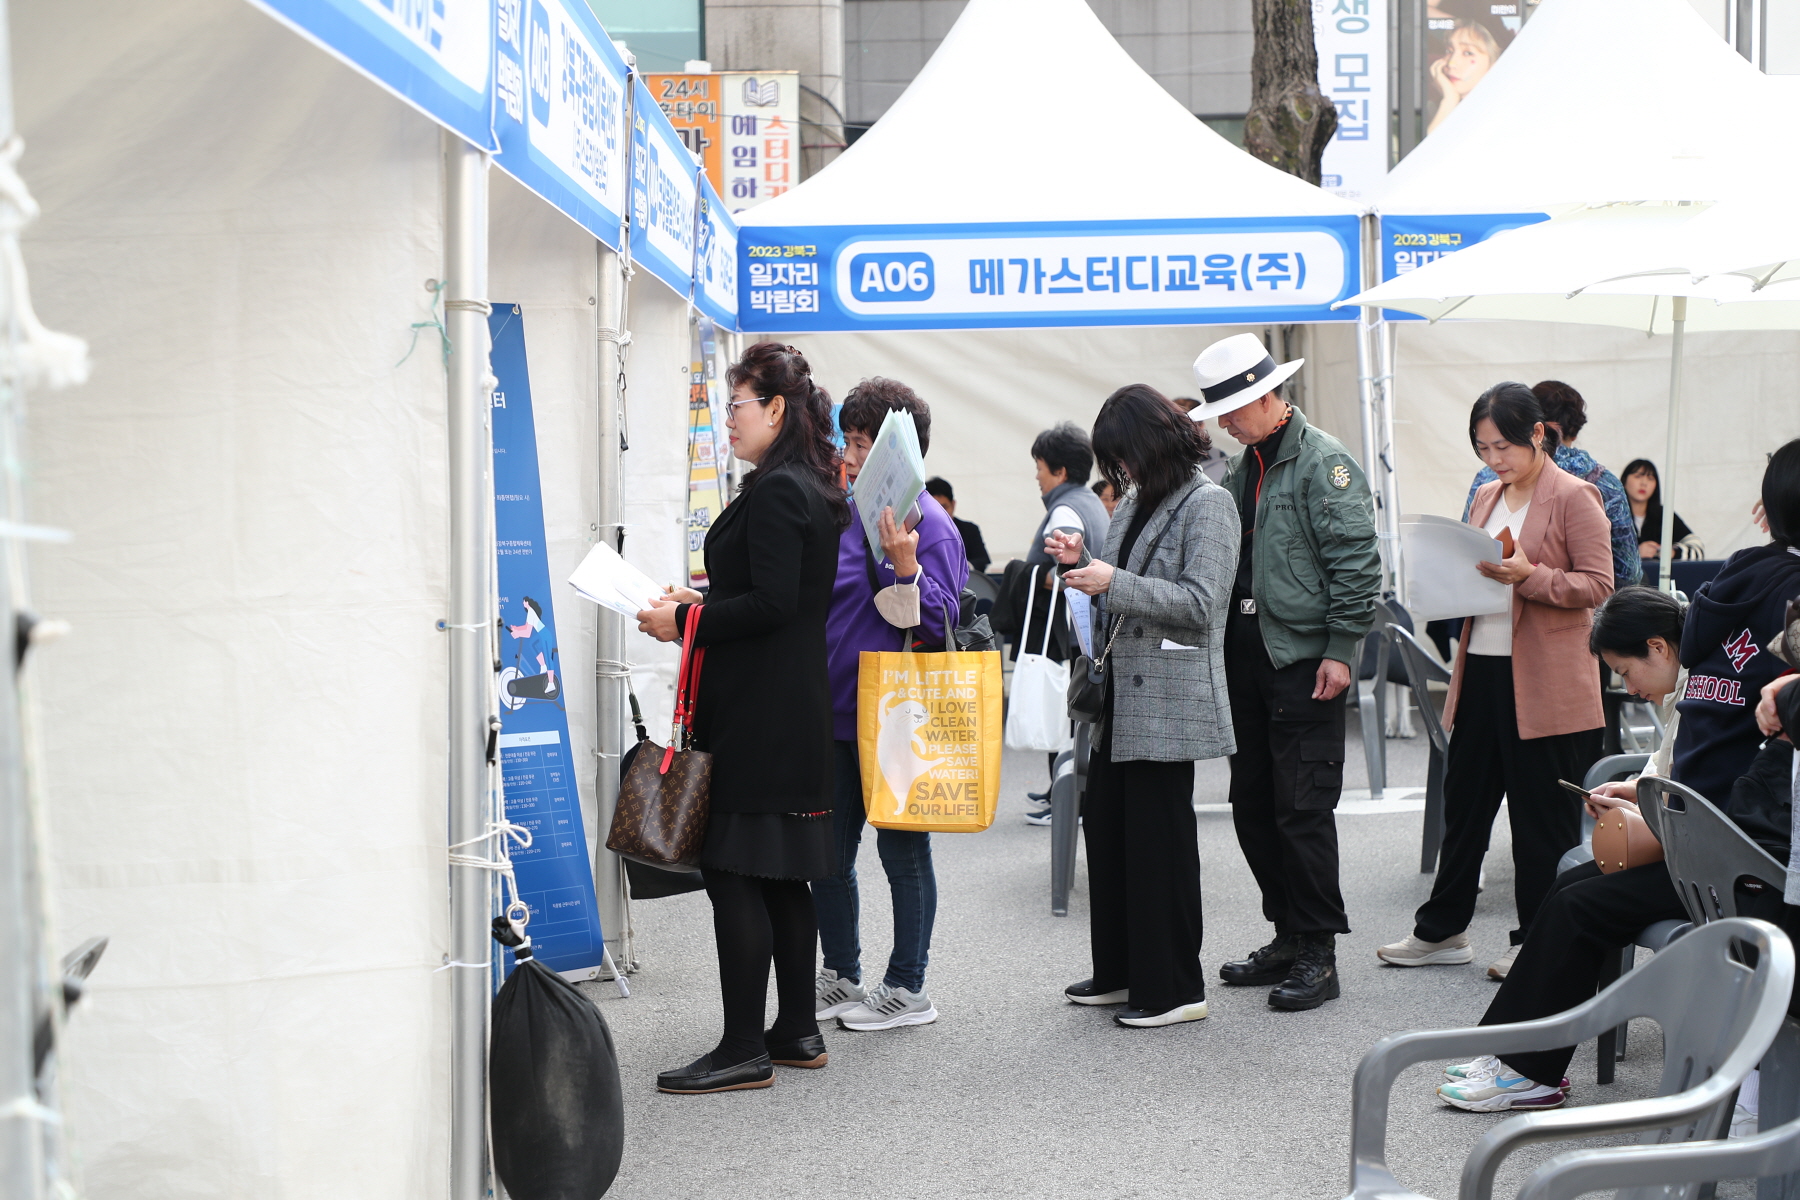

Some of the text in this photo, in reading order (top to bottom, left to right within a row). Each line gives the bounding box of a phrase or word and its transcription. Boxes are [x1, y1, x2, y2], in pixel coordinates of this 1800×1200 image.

[531, 19, 549, 103] A03
[660, 78, 710, 99] 24시
[1333, 53, 1371, 141] 모집
[732, 115, 758, 214] 에임하
[1393, 233, 1462, 246] 2023 강북구
[748, 245, 817, 257] 2023 강북구
[749, 263, 818, 286] 일자리
[860, 261, 929, 292] A06
[969, 252, 1306, 295] 메가스터디교육(주)
[750, 289, 819, 313] 박람회
[491, 391, 506, 408] 터
[883, 670, 977, 685] I'M LITTLE
[946, 687, 977, 699] AND
[1686, 675, 1745, 706] SCHOOL
[930, 702, 976, 714] I LOVE
[930, 716, 976, 728] CLEAN
[926, 730, 979, 742] WATER.
[928, 744, 977, 754] PLEASE
[946, 756, 977, 767] SAVE
[928, 769, 979, 780] WATER!
[916, 782, 979, 801] SAVE
[908, 803, 979, 816] OUR LIFE!
